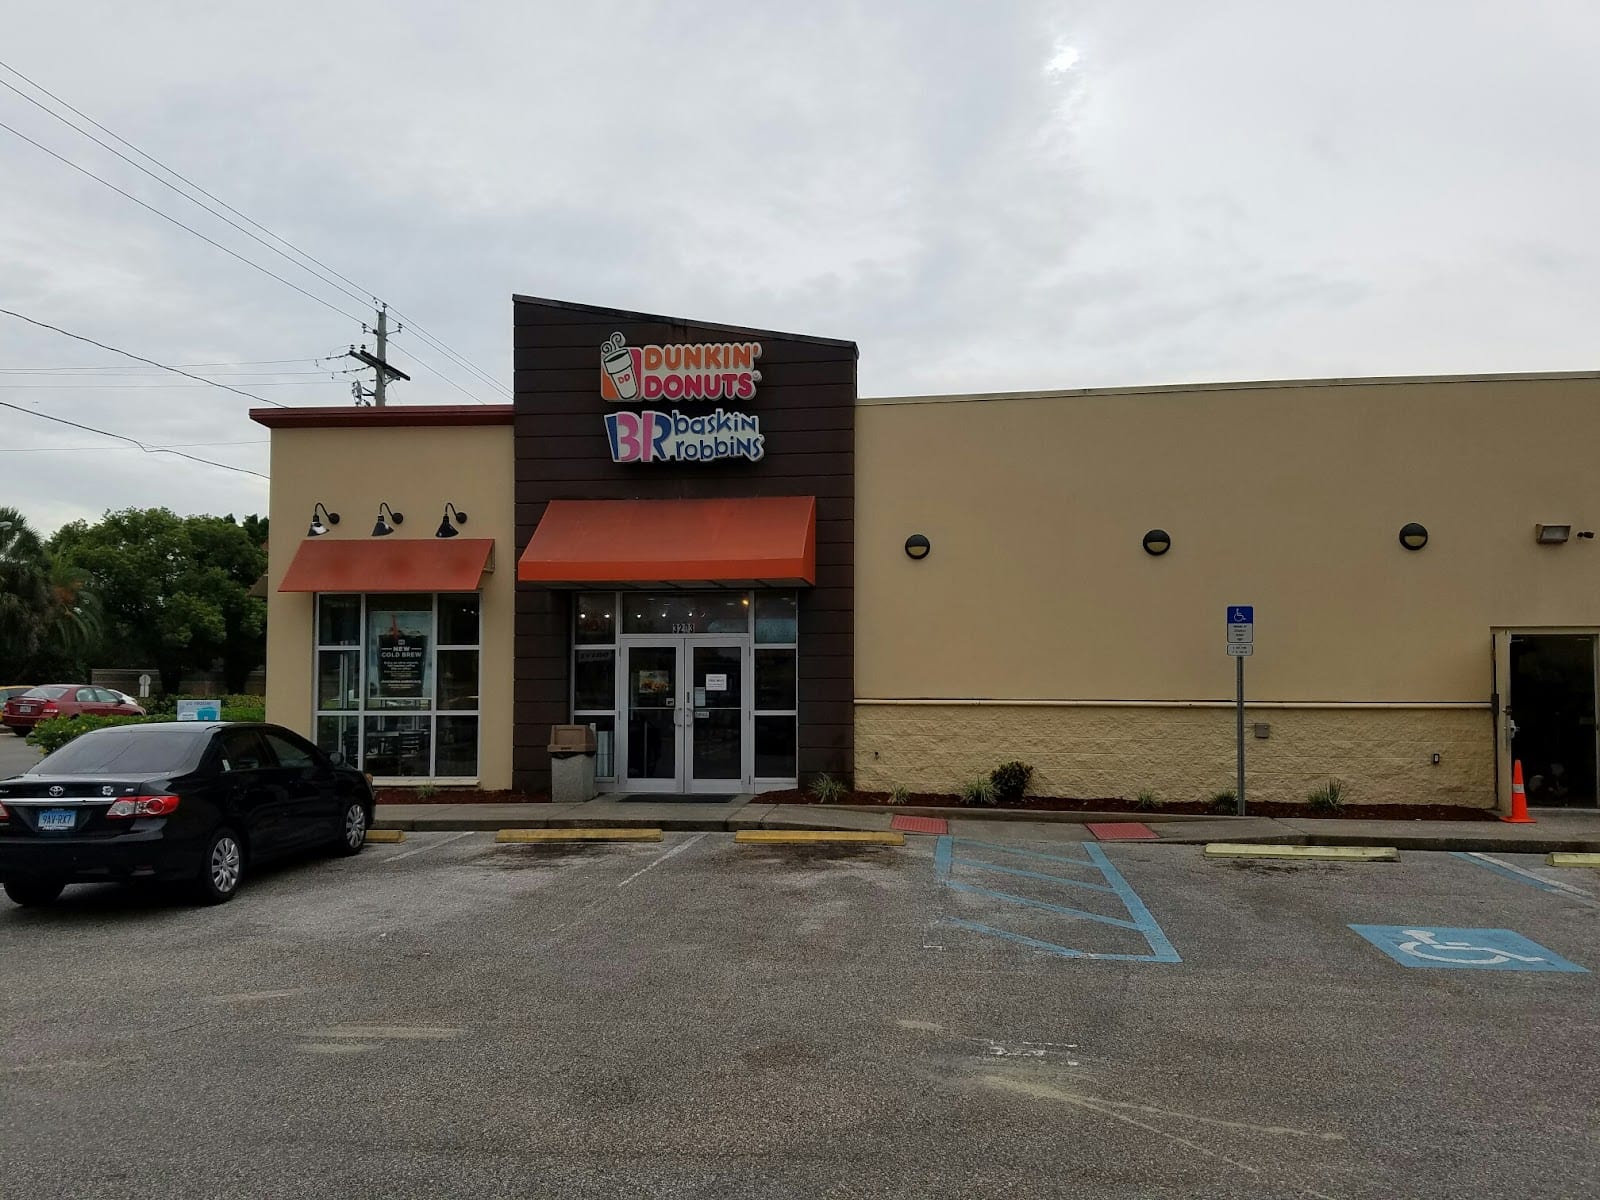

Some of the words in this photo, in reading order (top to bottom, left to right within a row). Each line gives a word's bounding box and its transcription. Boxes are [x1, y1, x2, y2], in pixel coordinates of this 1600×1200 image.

[644, 344, 760, 371] DUNKIN'
[617, 373, 631, 384] DD
[644, 373, 753, 399] DONUTS
[672, 410, 757, 436] baskin
[605, 412, 672, 461] BR
[675, 434, 761, 460] robbins
